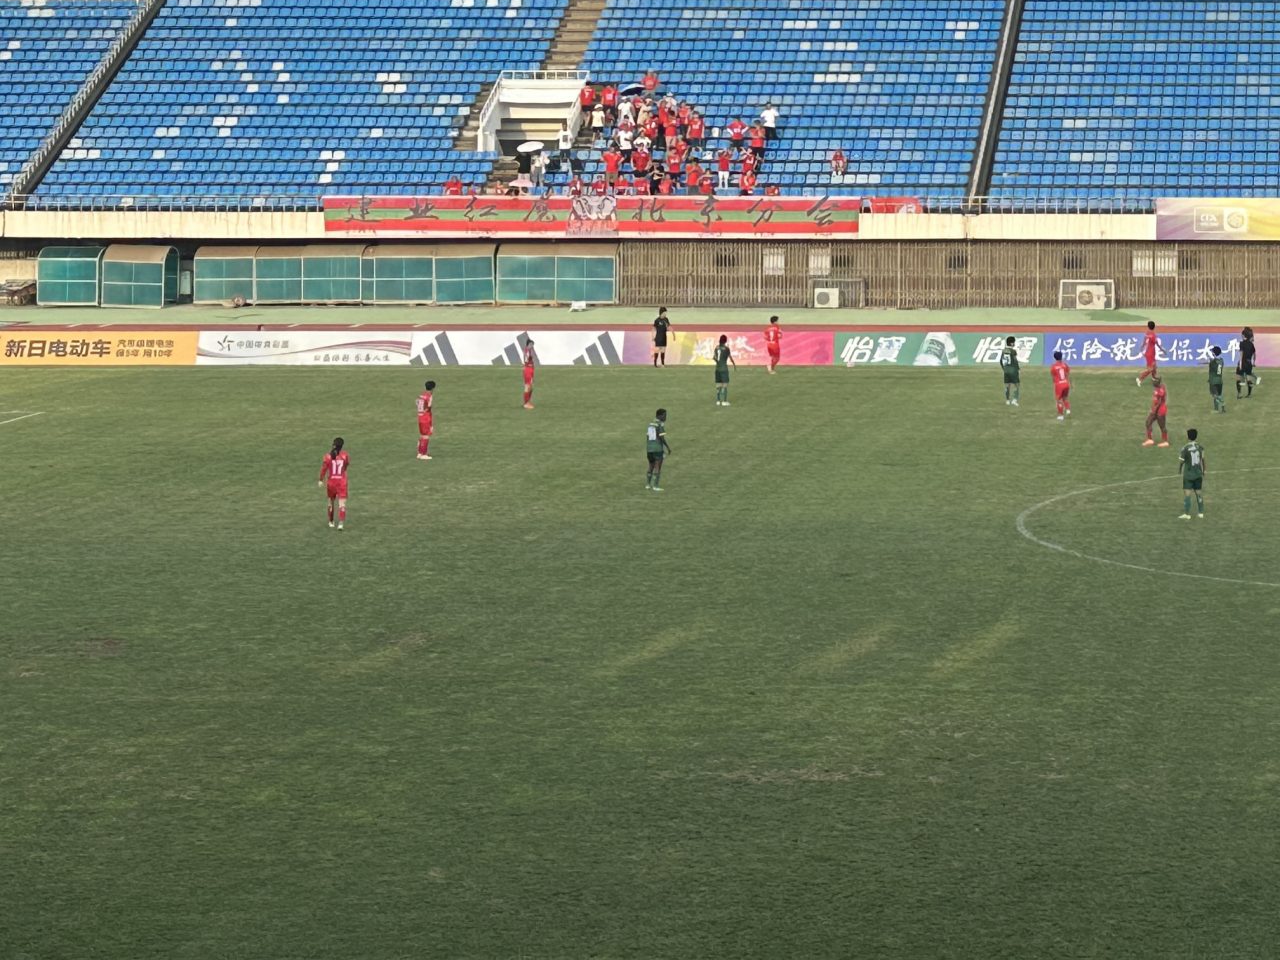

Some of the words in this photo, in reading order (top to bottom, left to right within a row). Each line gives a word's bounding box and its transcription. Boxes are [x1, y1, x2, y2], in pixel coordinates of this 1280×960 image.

[5, 340, 112, 357] 新日电动车
[331, 459, 344, 475] 17
